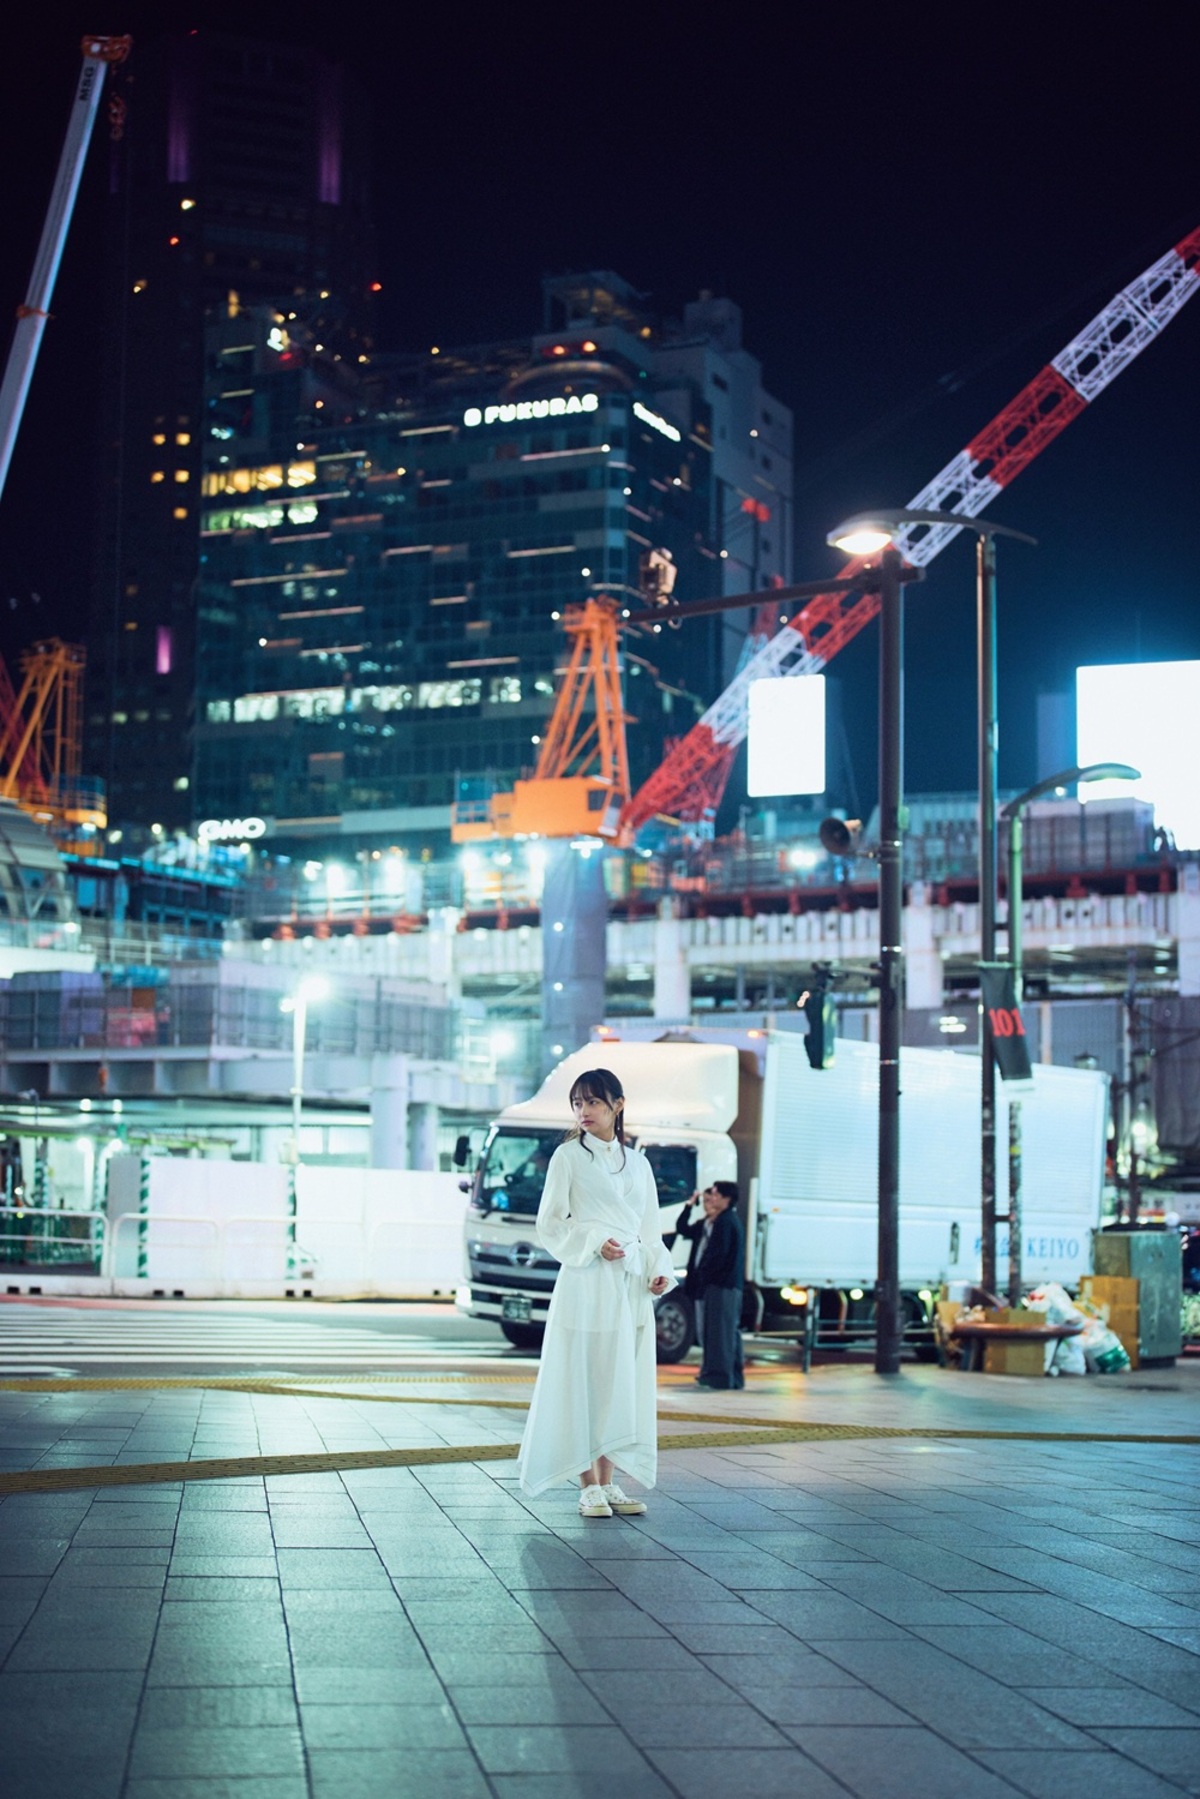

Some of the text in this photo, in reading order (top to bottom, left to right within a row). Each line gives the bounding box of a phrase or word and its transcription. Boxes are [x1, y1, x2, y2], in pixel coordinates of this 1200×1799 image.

[485, 393, 599, 424] FUKURAS
[198, 817, 266, 841] GMO
[988, 1007, 1026, 1037] 101
[1026, 1237, 1080, 1259] KEIYO
